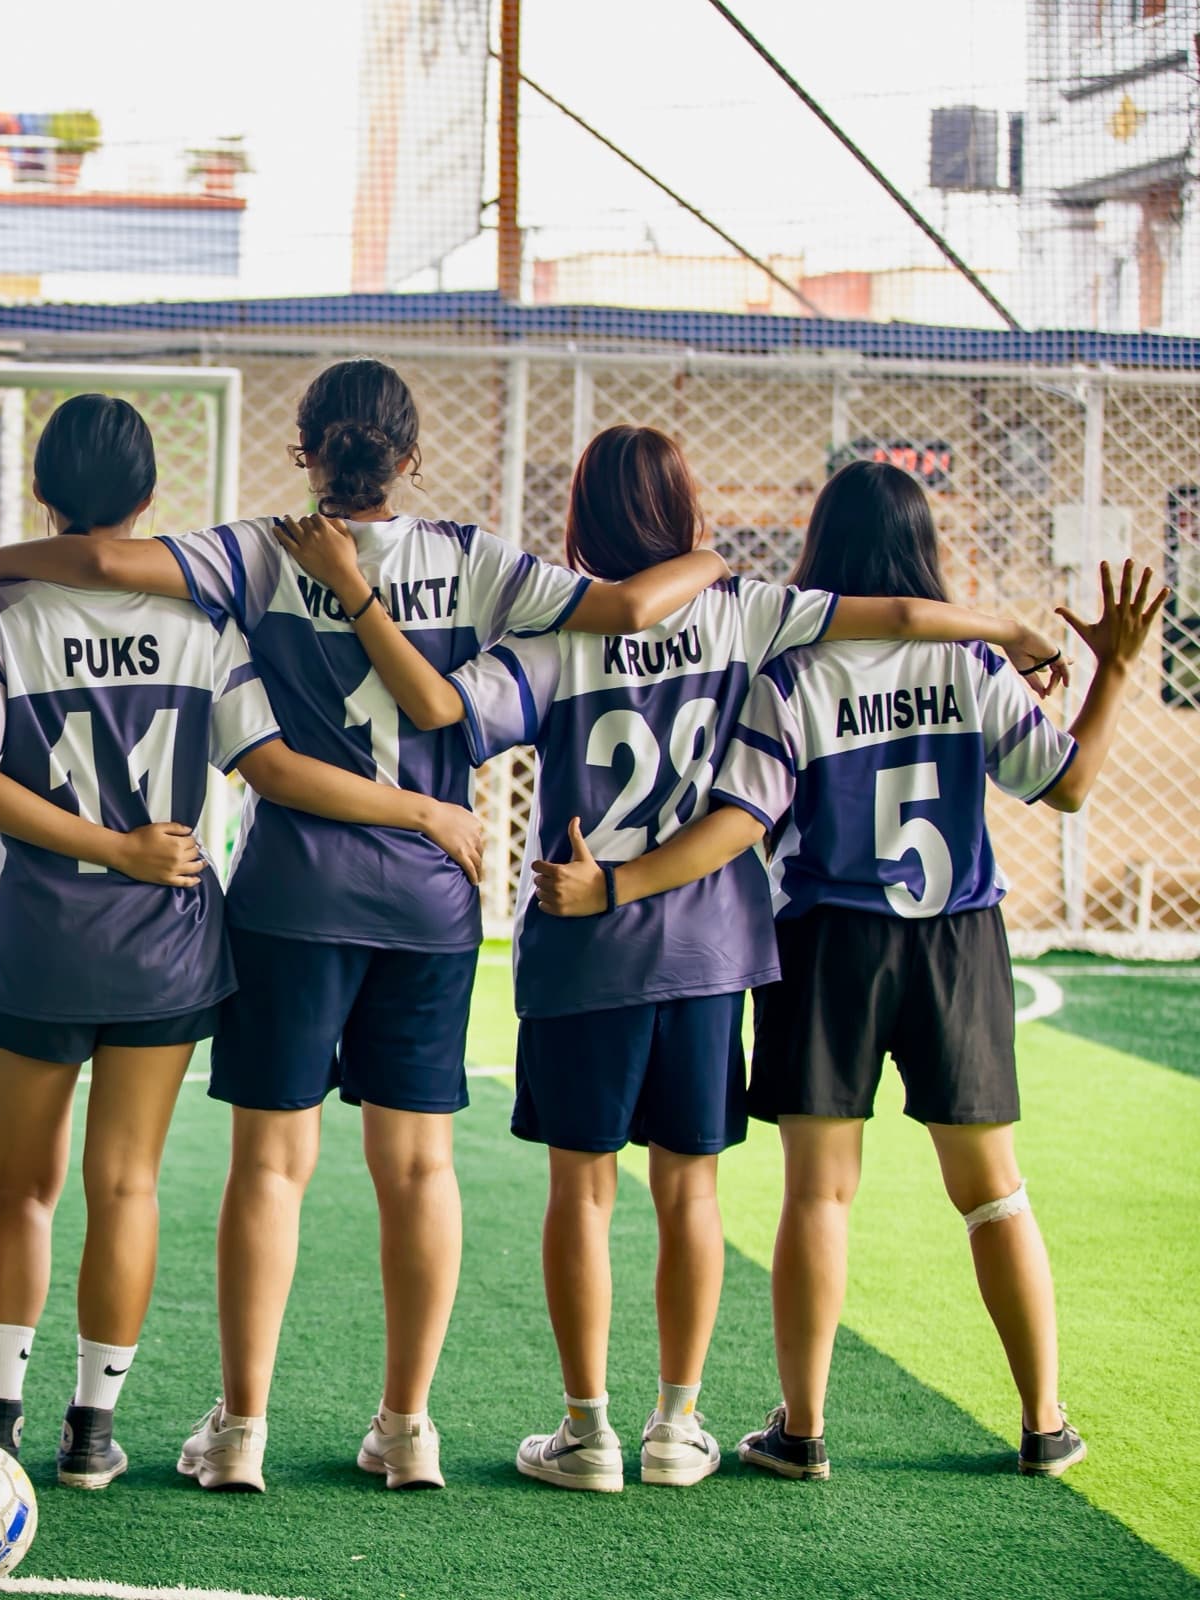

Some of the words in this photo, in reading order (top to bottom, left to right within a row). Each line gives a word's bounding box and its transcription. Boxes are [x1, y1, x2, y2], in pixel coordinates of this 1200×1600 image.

[64, 634, 160, 677] PUKS
[835, 684, 963, 738] AMISHA
[50, 708, 179, 875] 11
[585, 697, 716, 862] 28
[874, 762, 953, 918] 5
